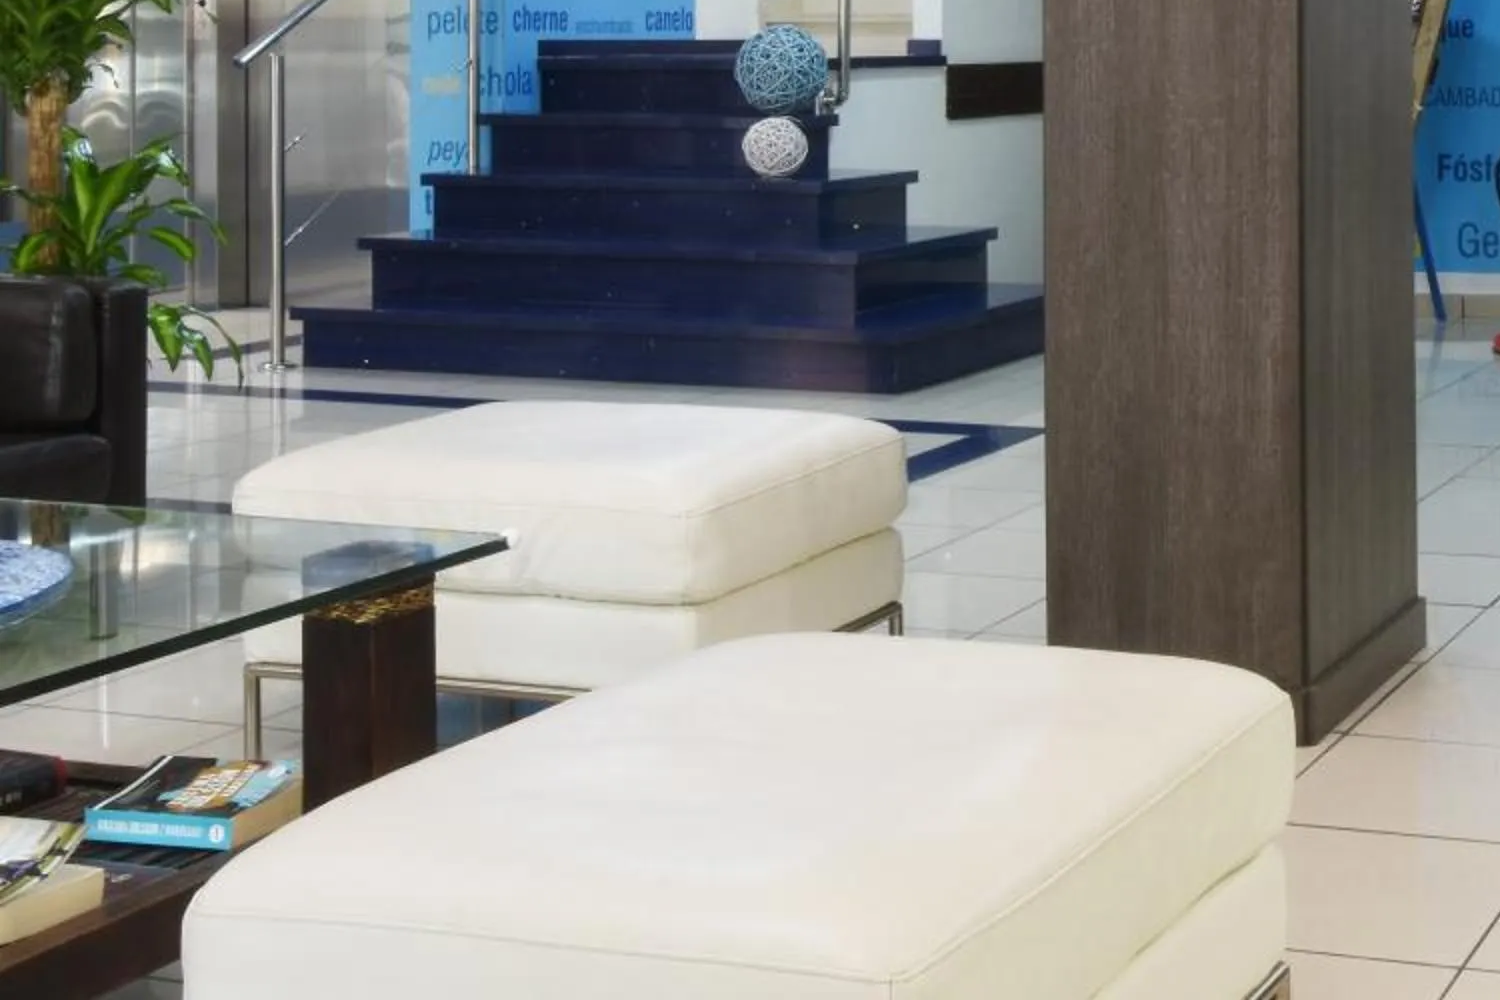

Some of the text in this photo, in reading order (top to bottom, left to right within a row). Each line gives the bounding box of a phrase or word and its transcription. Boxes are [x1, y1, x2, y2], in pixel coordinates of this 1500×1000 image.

[427, 6, 498, 39] pelte
[513, 3, 569, 33] cherne
[645, 6, 693, 33] canelo
[427, 137, 469, 166] pey
